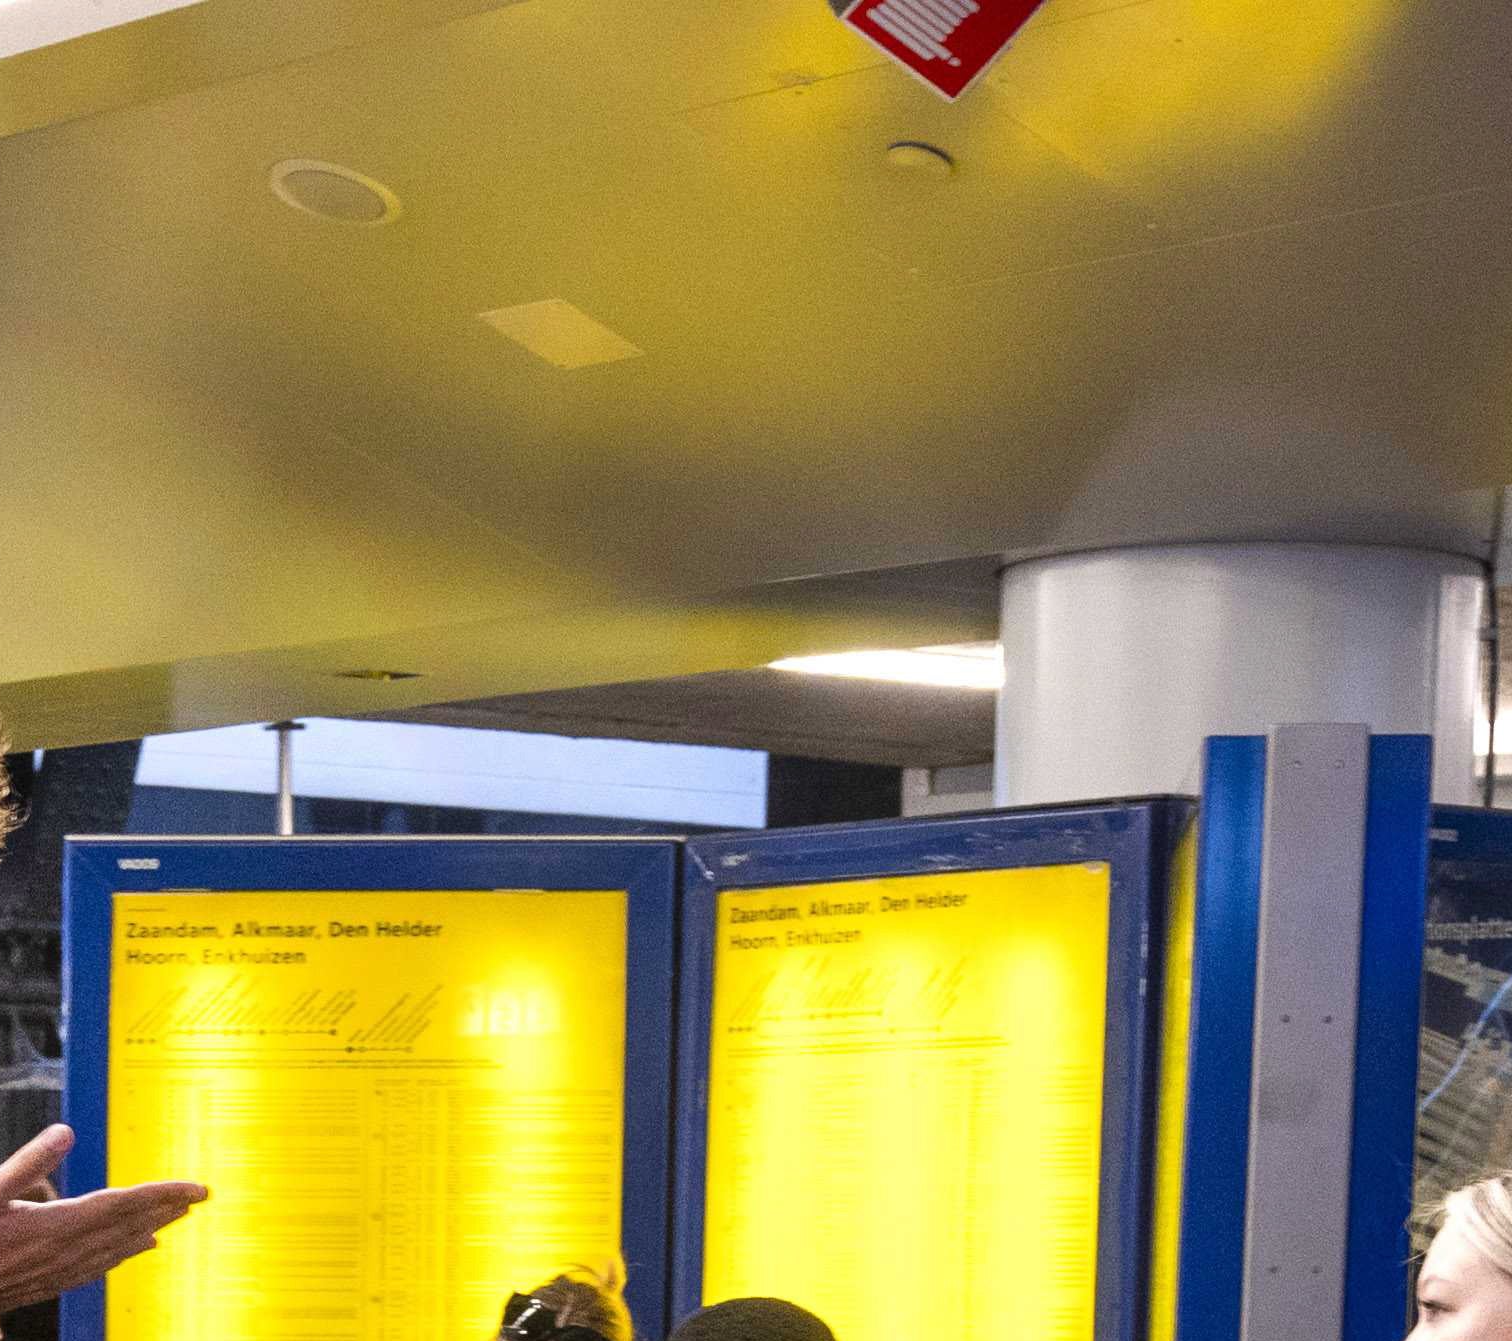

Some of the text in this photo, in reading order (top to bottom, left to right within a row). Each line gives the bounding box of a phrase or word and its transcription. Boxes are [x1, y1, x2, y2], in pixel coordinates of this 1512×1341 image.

[879, 896, 910, 913] Den
[127, 920, 443, 939] Zaandam, Alkmaar, Den Helder
